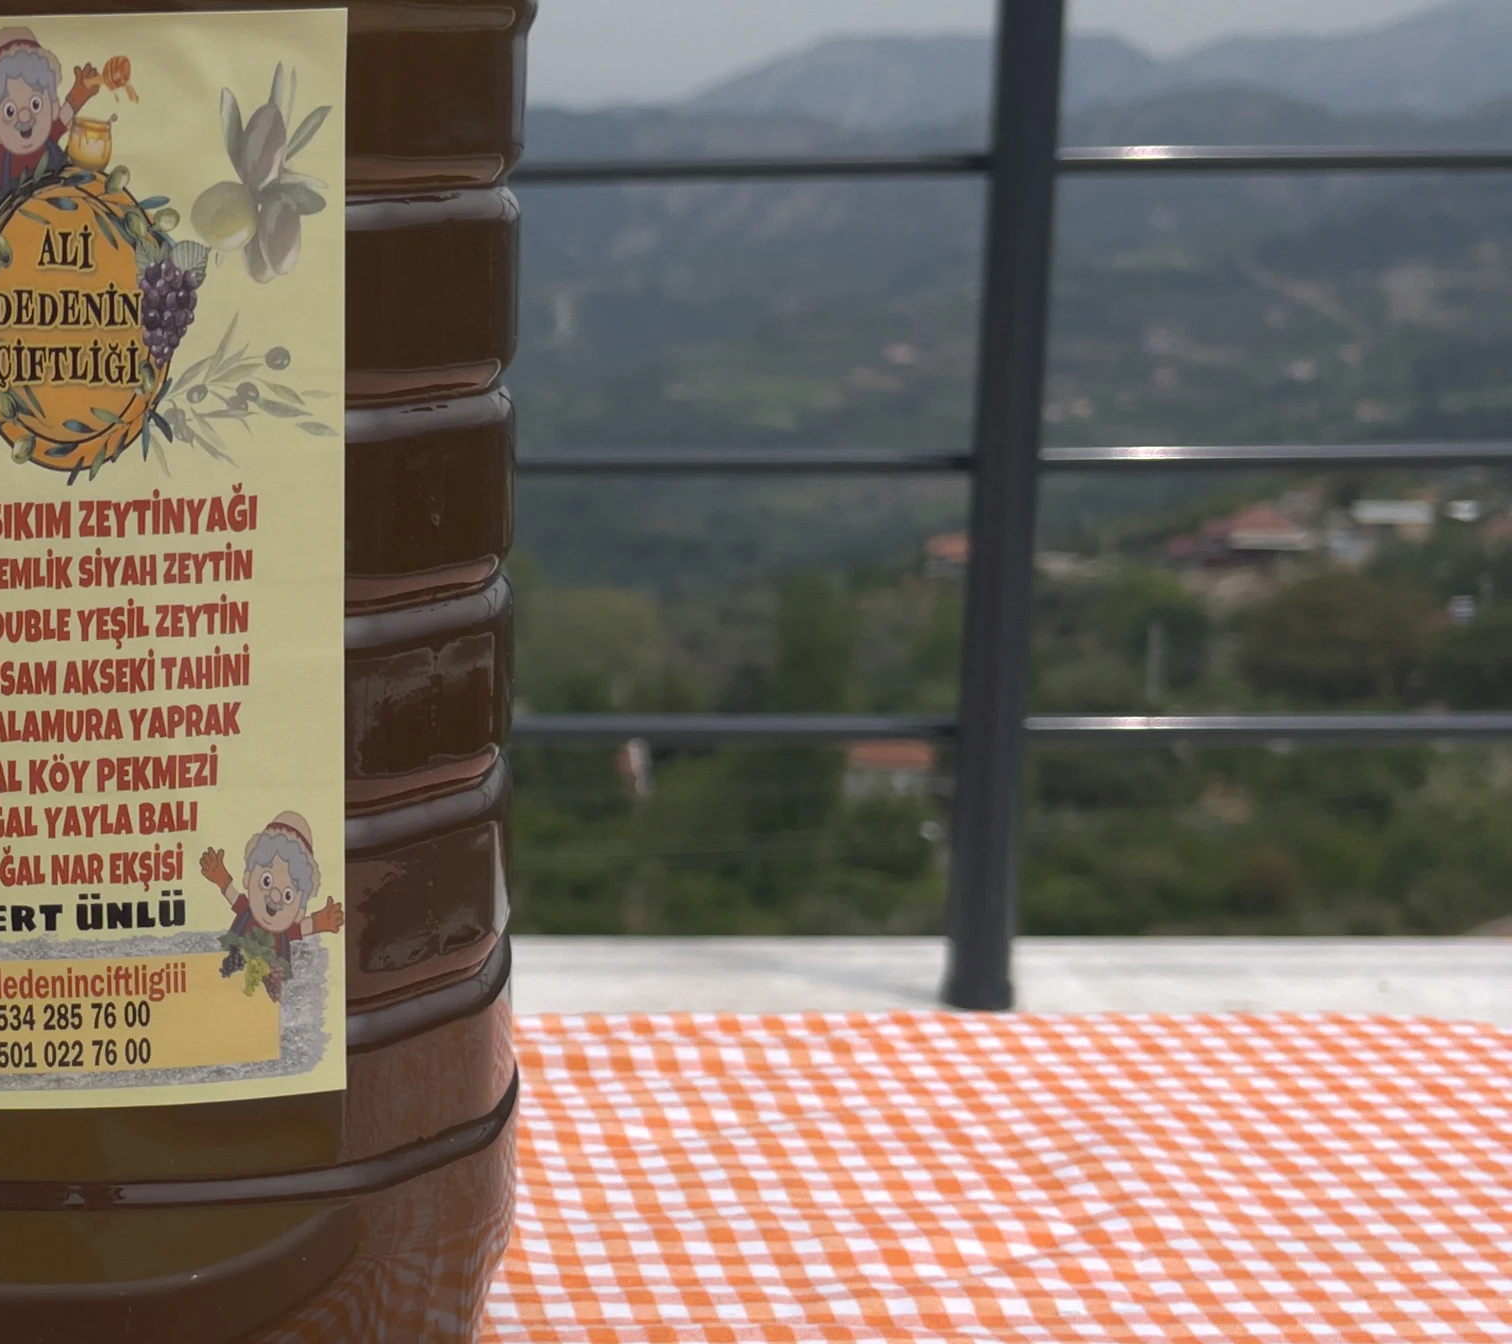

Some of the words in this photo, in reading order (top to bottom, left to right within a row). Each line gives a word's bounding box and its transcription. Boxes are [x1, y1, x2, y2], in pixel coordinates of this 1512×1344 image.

[38, 225, 93, 269] ALİ
[79, 483, 257, 538] ZEYTİNYAĞI
[78, 548, 157, 588] SİYAH
[163, 542, 252, 583] ZEYTİN
[77, 598, 149, 649] YEŞİL
[155, 594, 249, 637] ZEYTİN
[63, 649, 154, 695] AKSEKİ
[161, 644, 249, 688] TAHİNİ
[129, 702, 242, 740] YAPRAK
[29, 754, 88, 793] KÖY
[97, 745, 218, 791] PEKMEZİ
[44, 804, 132, 838] YAYLA
[139, 802, 198, 833] BALI
[52, 854, 104, 885] NAR
[110, 843, 184, 891] EKŞİSİ
[43, 1004, 83, 1030] 285
[91, 1002, 117, 1028] 76
[124, 1000, 151, 1027] 00
[44, 1040, 84, 1067] 022
[91, 1039, 117, 1066] 76
[124, 1037, 151, 1064] 00
